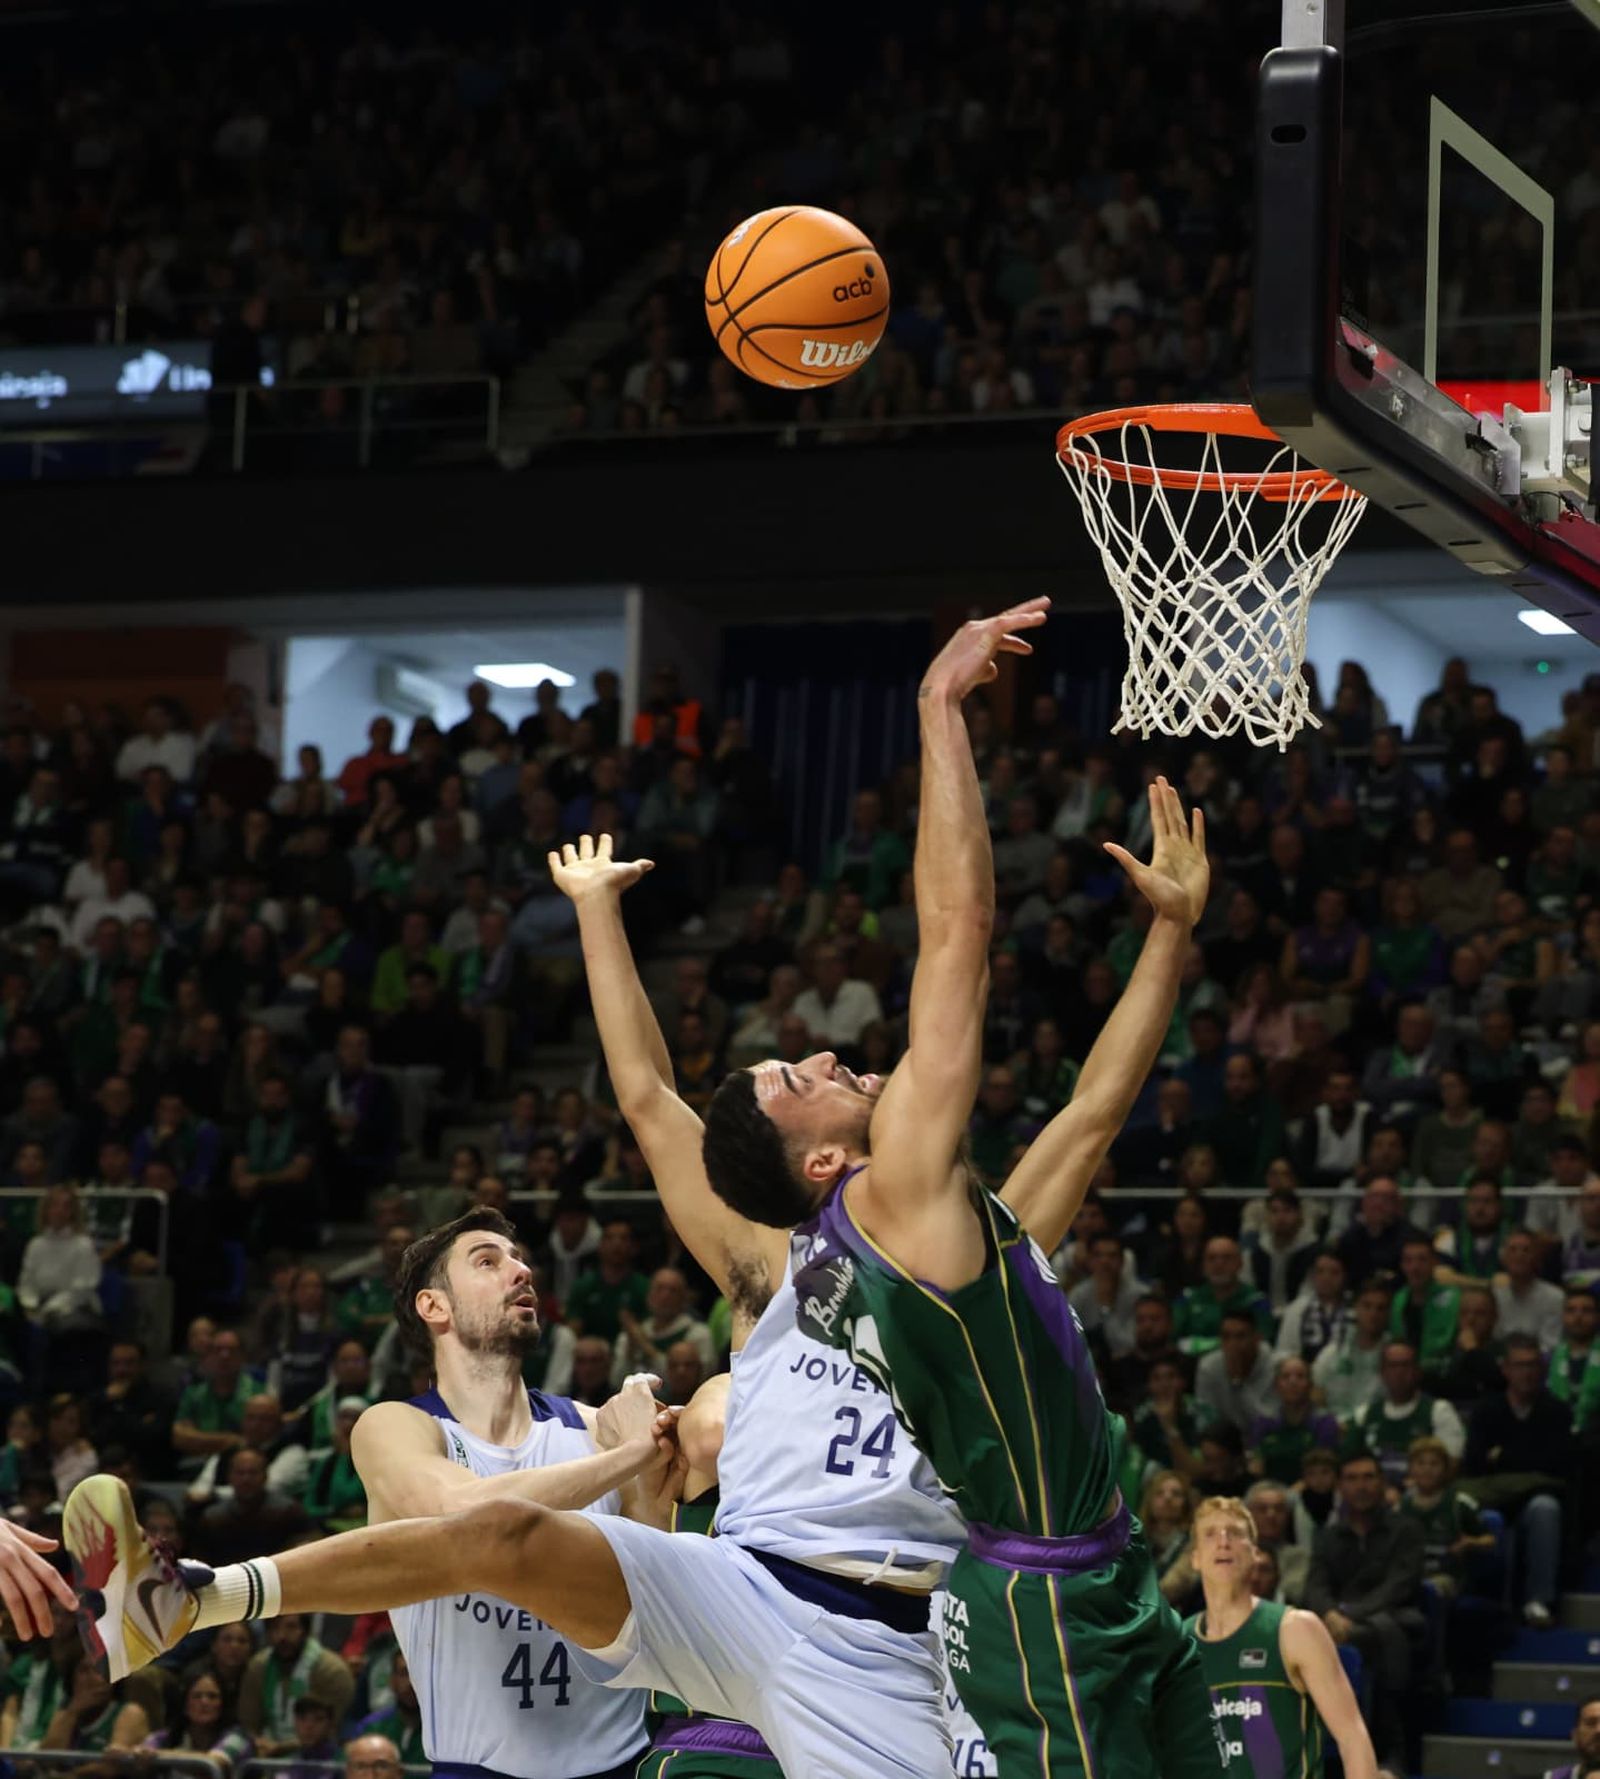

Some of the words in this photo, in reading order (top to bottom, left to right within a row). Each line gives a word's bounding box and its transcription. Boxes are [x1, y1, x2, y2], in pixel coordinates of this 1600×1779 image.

[832, 277, 873, 303] acb
[800, 338, 880, 368] Wils
[790, 1352, 881, 1395] JOVE
[825, 1406, 897, 1479] 24
[502, 1641, 571, 1709] 44
